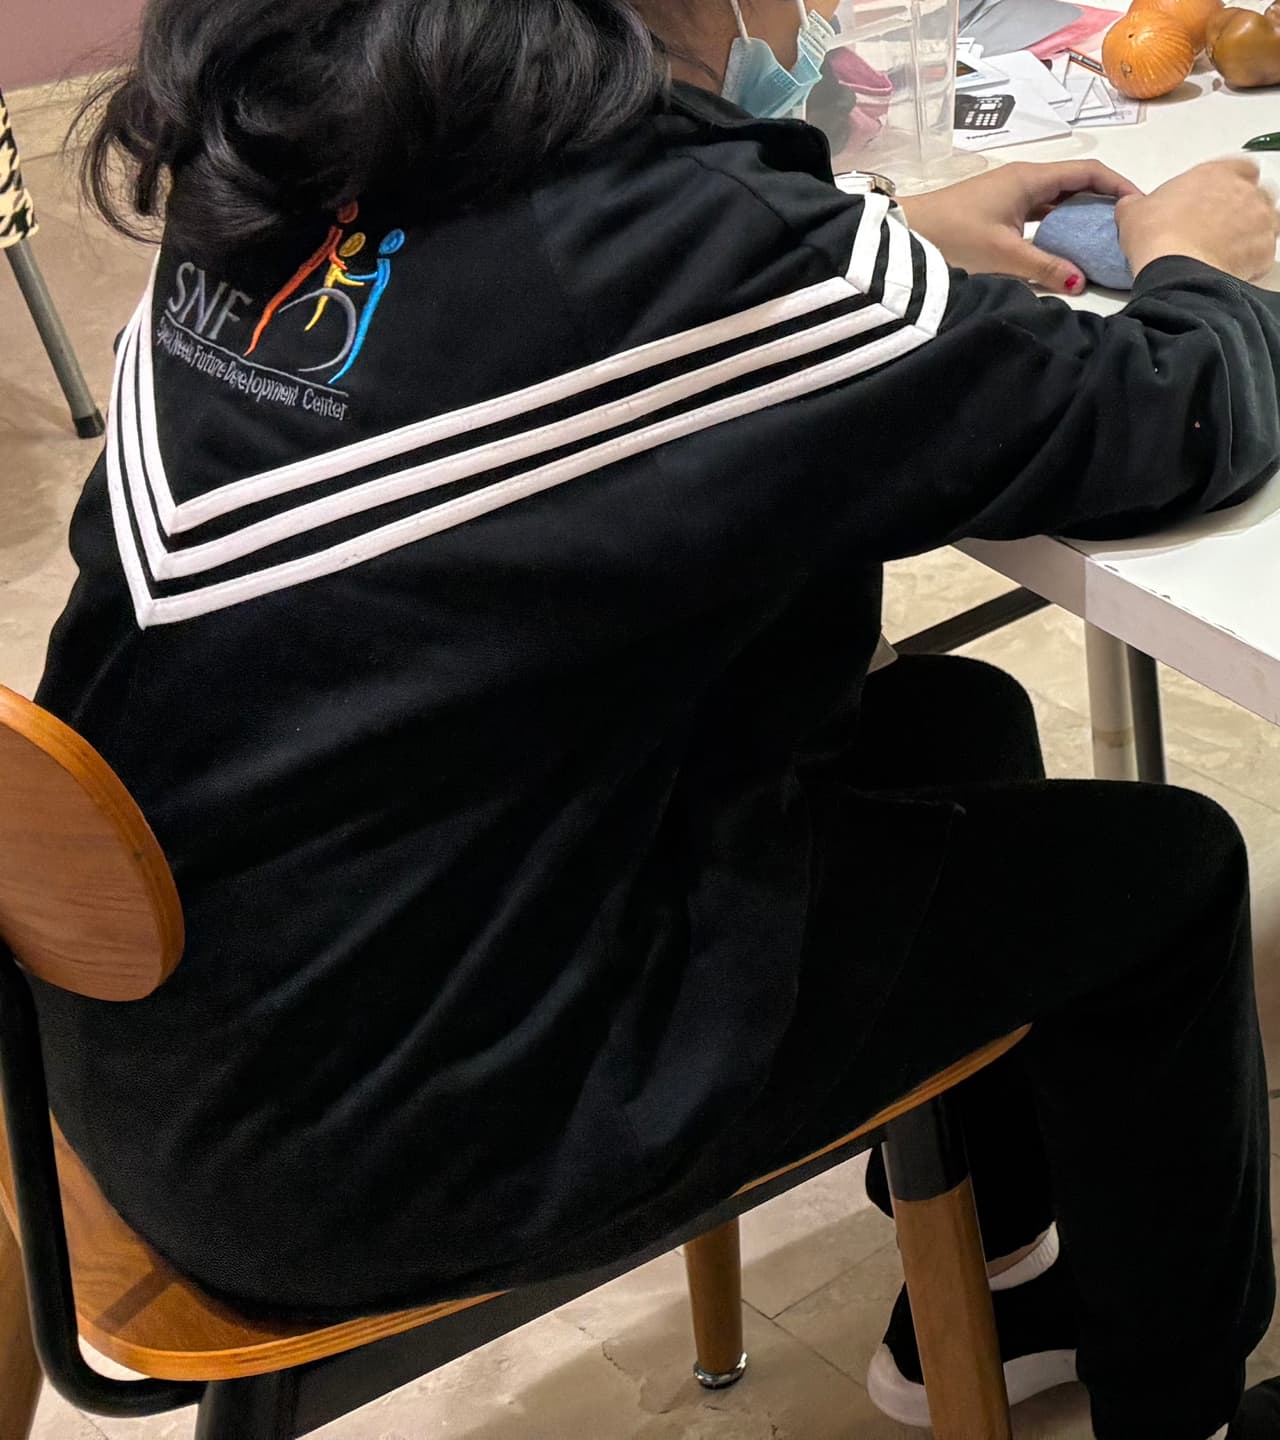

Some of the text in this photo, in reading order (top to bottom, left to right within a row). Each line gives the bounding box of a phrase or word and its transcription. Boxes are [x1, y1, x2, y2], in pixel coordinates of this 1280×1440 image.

[167, 262, 253, 340] SNF
[190, 344, 228, 378] Future
[223, 360, 300, 406] Development
[302, 388, 348, 421] Center
